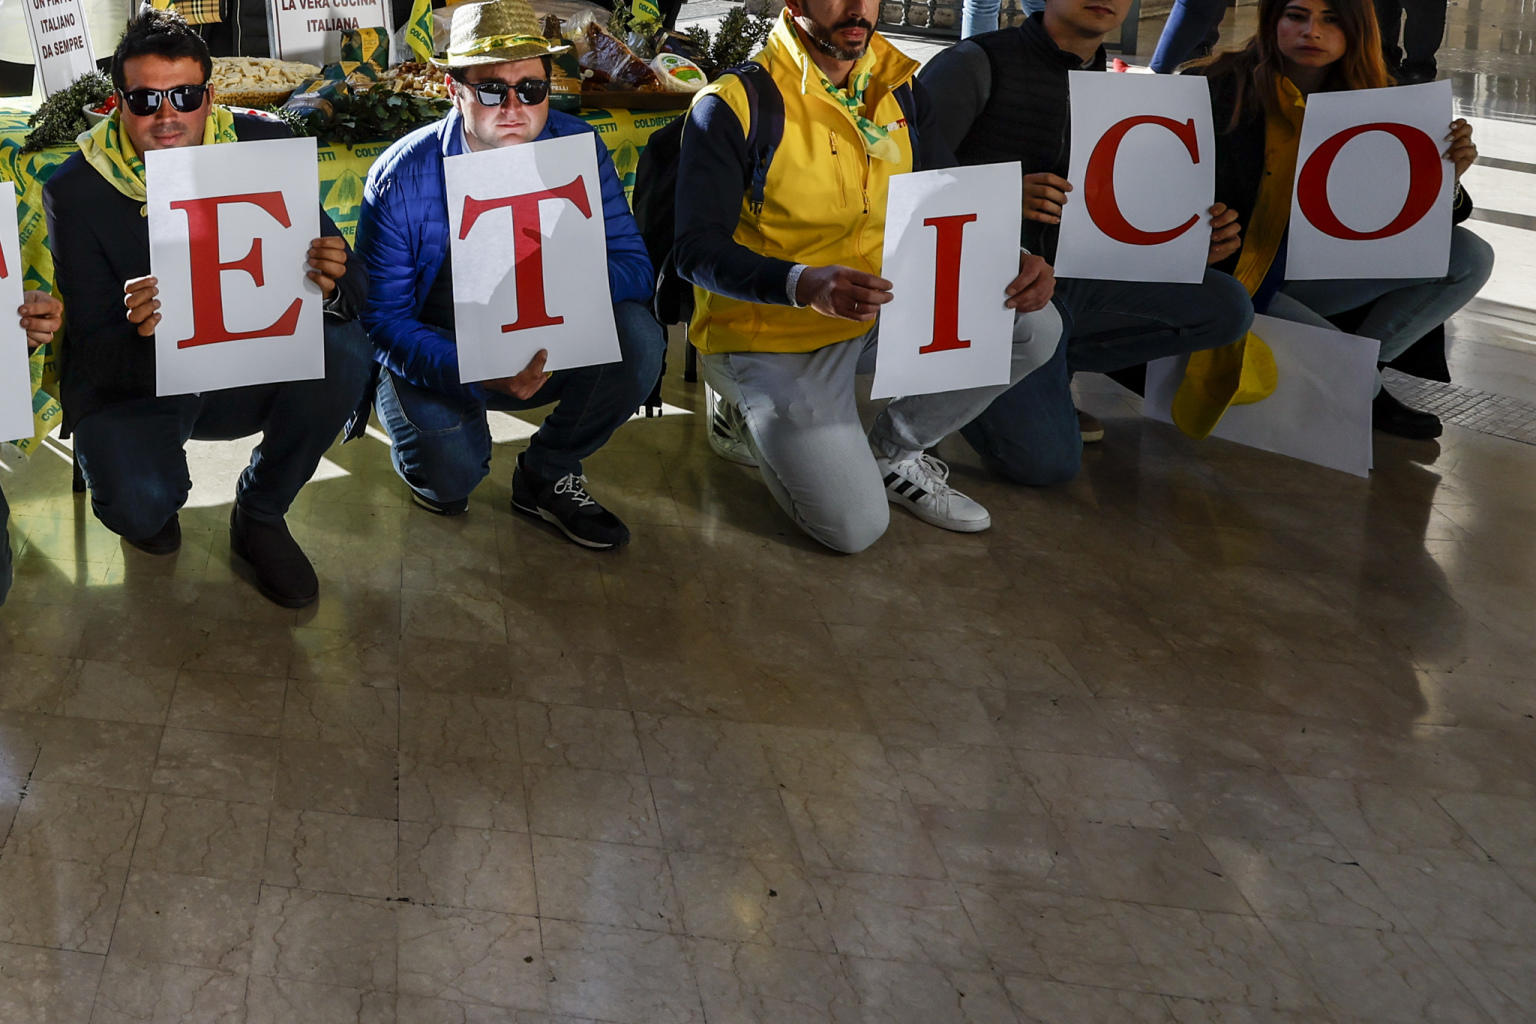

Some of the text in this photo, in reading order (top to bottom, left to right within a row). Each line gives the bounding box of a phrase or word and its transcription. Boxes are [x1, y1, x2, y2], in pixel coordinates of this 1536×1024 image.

[40, 13, 75, 33] ITALIANO
[307, 17, 359, 32] ITALIANA
[42, 35, 84, 59] DA SEMPRE
